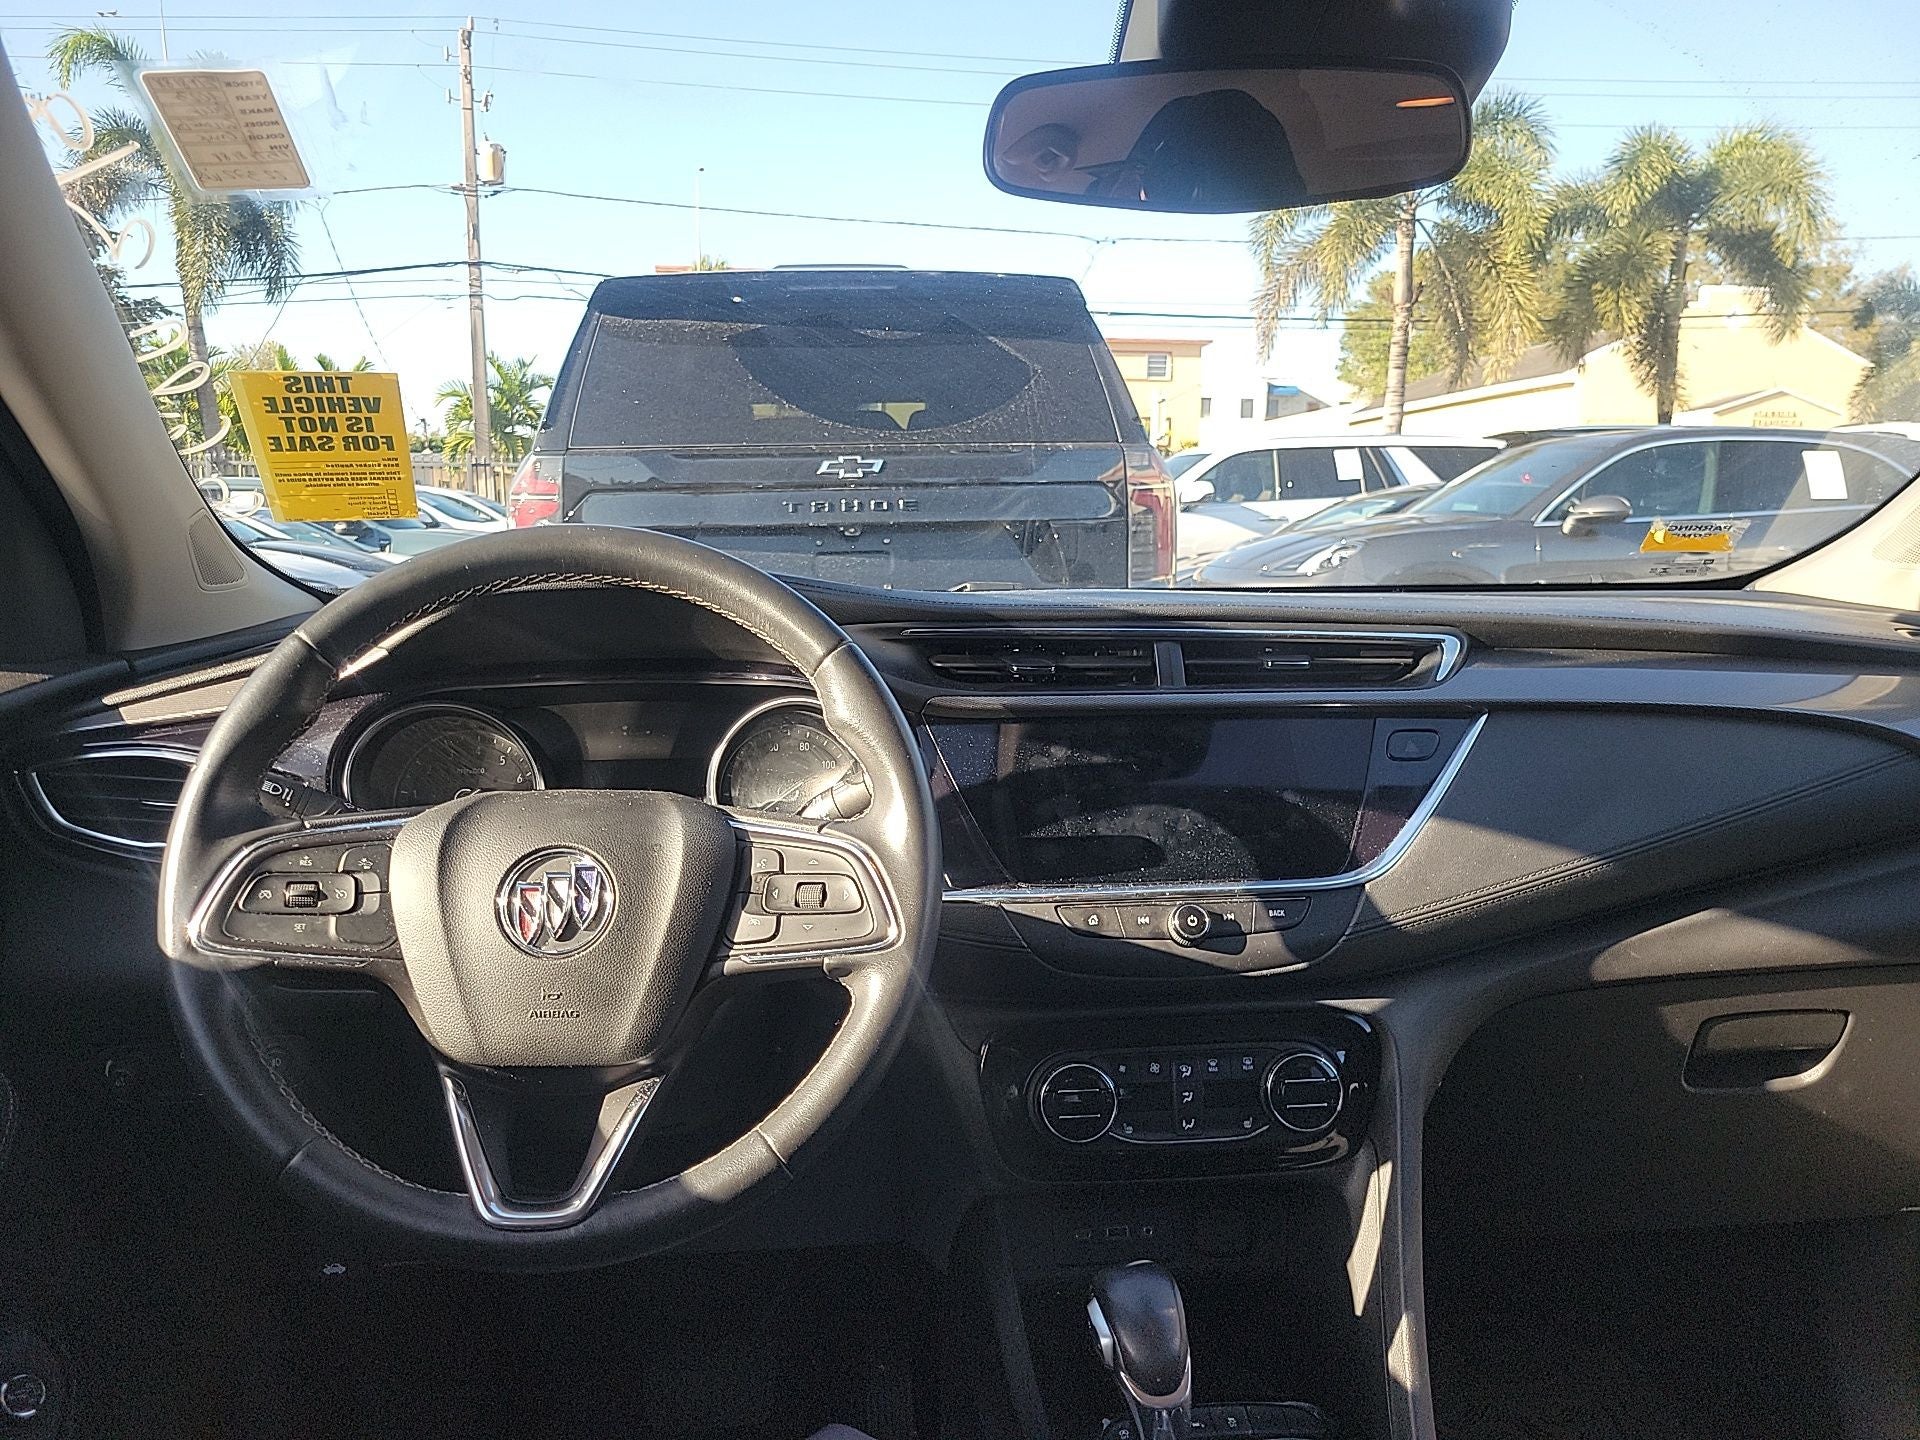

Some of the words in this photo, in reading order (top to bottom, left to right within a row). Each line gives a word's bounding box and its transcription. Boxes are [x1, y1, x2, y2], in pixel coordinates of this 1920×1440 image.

[781, 498, 918, 512] TAHOE
[799, 742, 810, 751] 80
[498, 756, 506, 766] 5
[821, 760, 836, 770] 100
[516, 773, 524, 784] 6
[530, 1010, 580, 1018] AIRBAG
